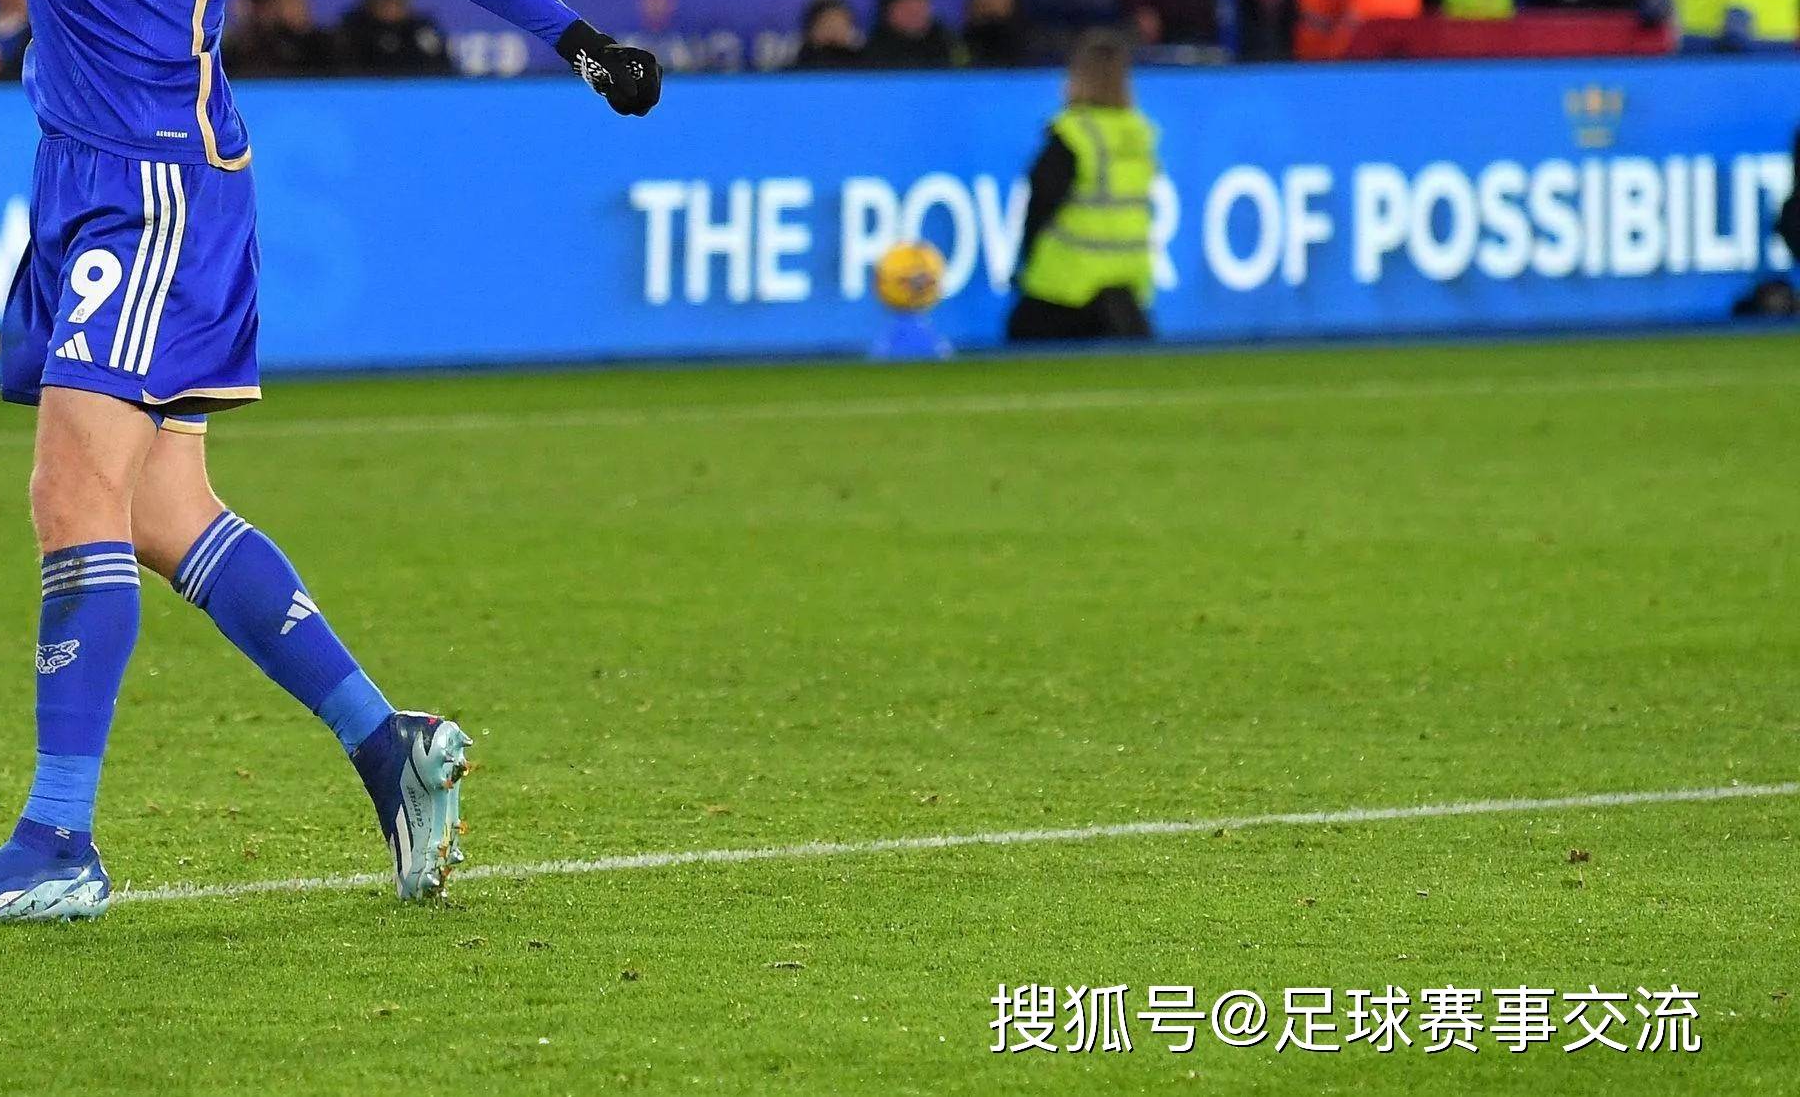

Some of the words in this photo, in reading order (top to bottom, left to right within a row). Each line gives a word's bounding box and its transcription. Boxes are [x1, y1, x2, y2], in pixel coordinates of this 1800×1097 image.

[68, 248, 123, 324] 9
[629, 176, 814, 304] THE
[1203, 163, 1335, 292] OF
